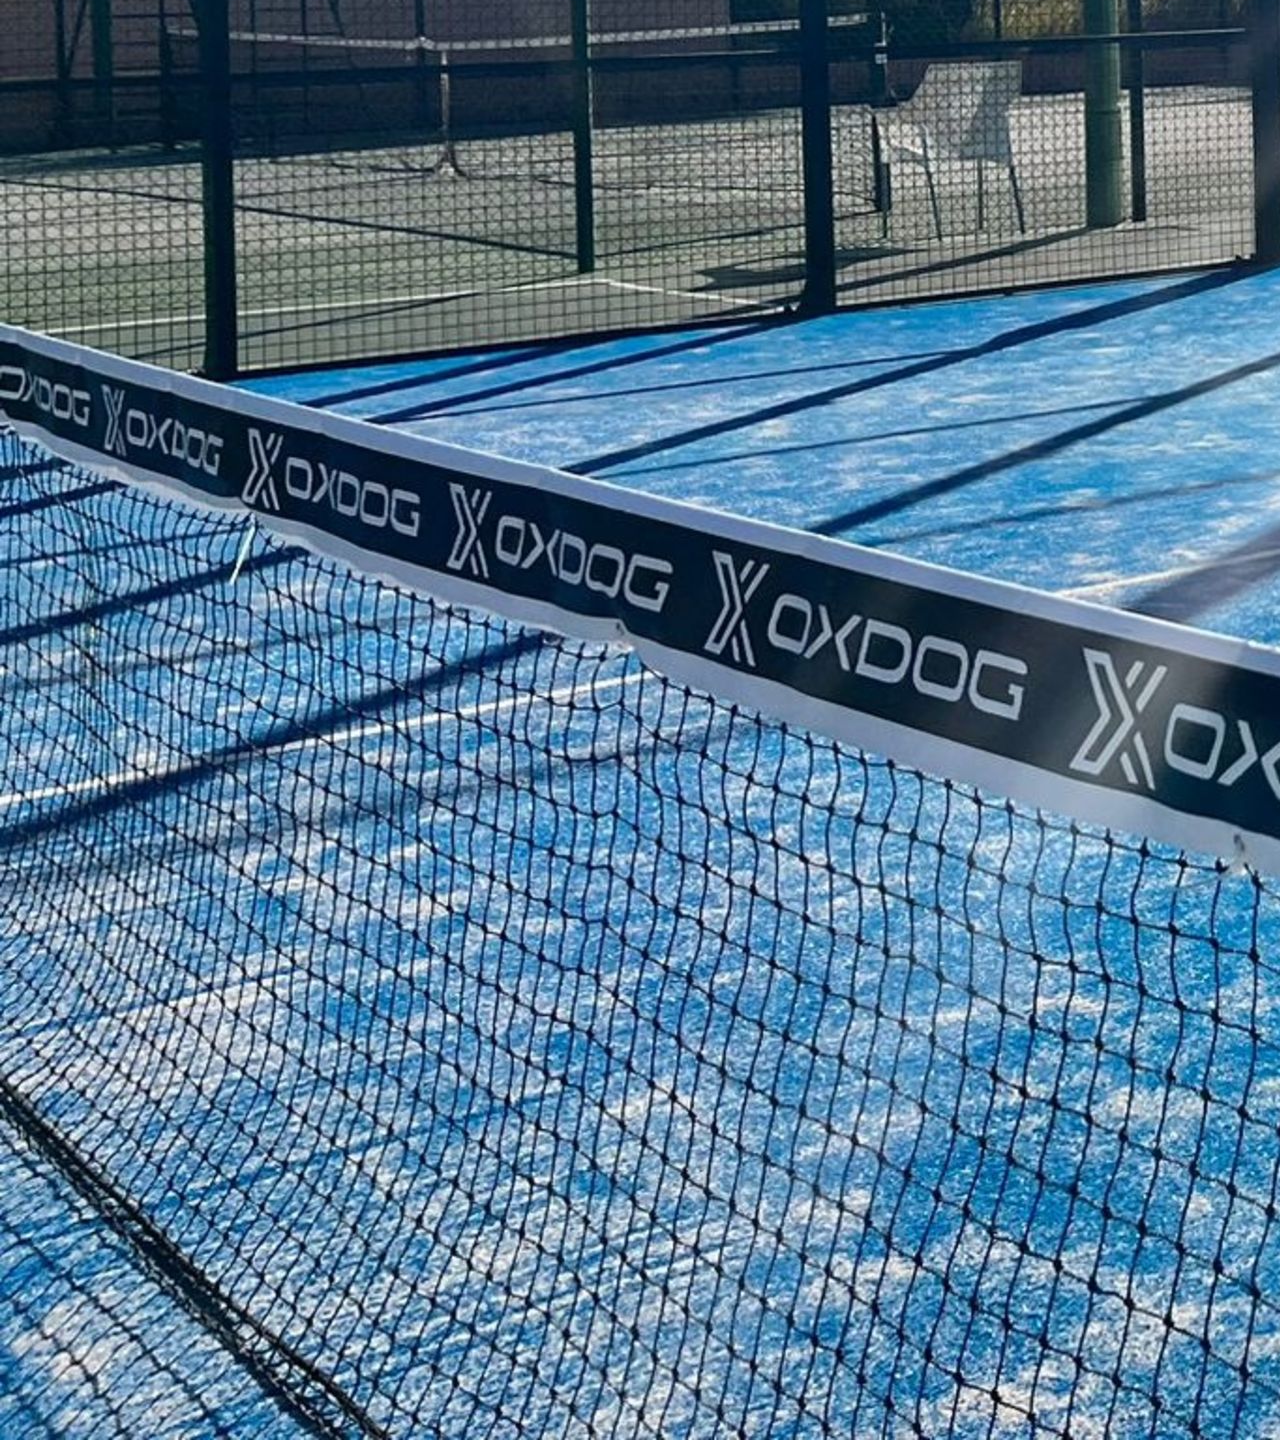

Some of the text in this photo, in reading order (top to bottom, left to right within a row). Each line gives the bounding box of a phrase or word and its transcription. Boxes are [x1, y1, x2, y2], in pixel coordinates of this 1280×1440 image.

[126, 408, 224, 477] OXDOG
[285, 457, 421, 538] OXDOG
[496, 515, 673, 613] OXDOG
[765, 592, 1029, 722] OXDOG
